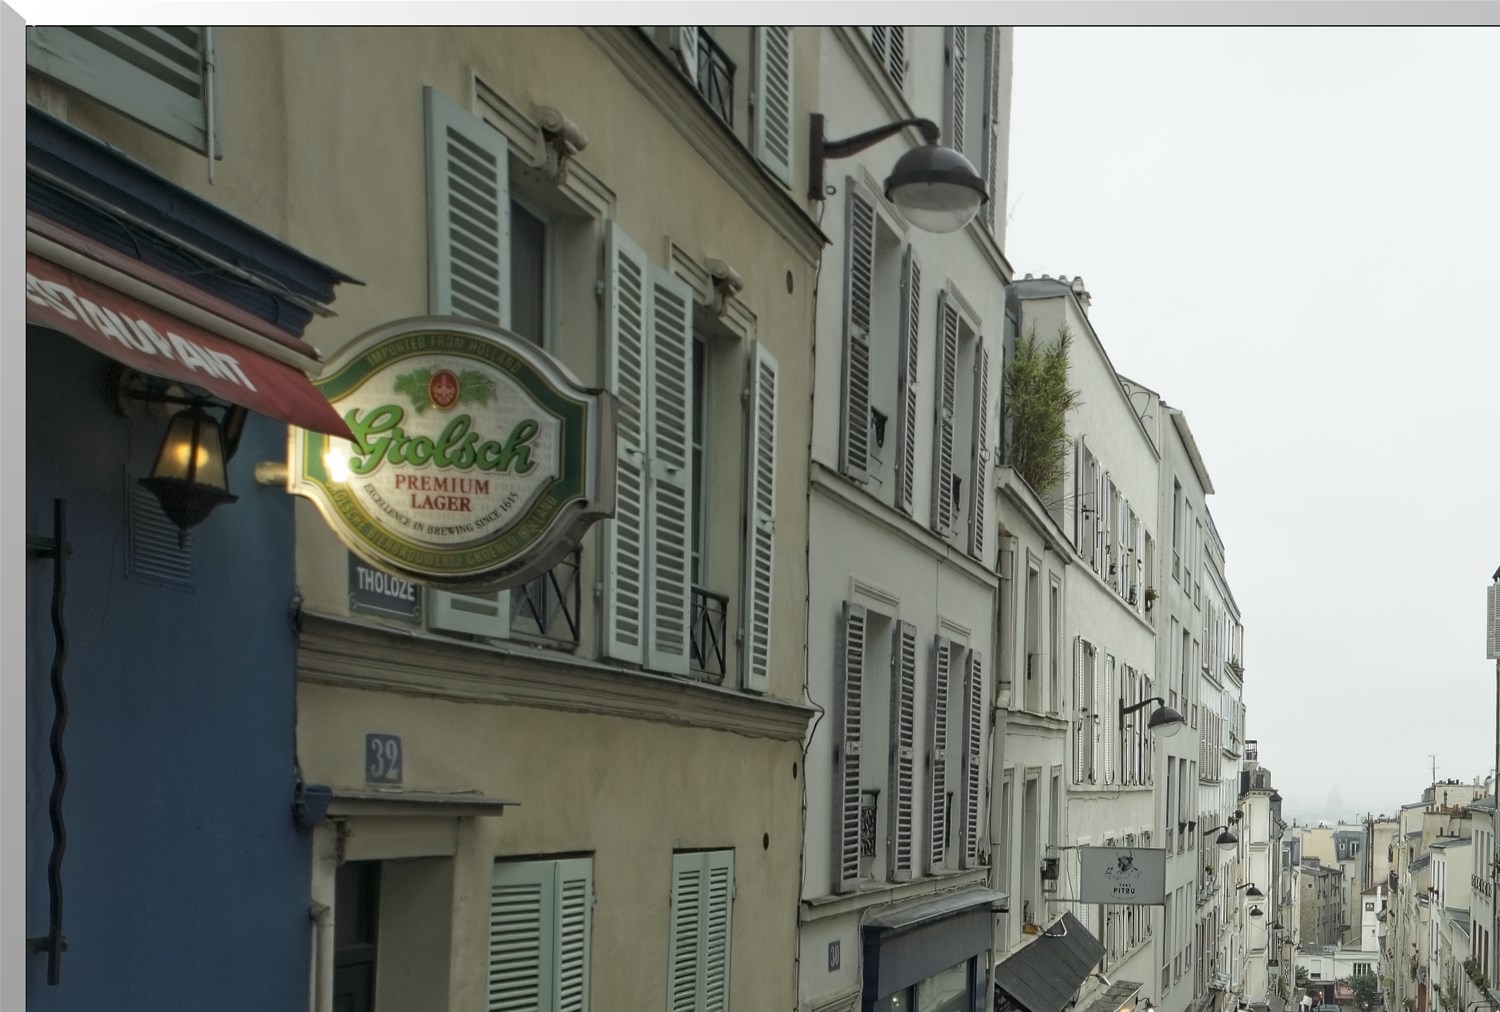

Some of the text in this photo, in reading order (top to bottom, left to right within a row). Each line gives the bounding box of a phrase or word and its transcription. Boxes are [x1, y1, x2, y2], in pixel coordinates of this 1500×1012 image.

[367, 335, 523, 373] IMPORTED FROM HOLLAND
[344, 404, 540, 475] Grolsch
[395, 474, 490, 496] PREMIUM
[411, 494, 472, 512] LAGER
[364, 483, 411, 528] EXCELLENCE
[413, 520, 424, 532] IN
[427, 523, 474, 536] BREWING
[476, 511, 501, 529] SINCE
[499, 490, 519, 512] 1615
[371, 738, 398, 779] 32
[1113, 887, 1136, 895] PITOU
